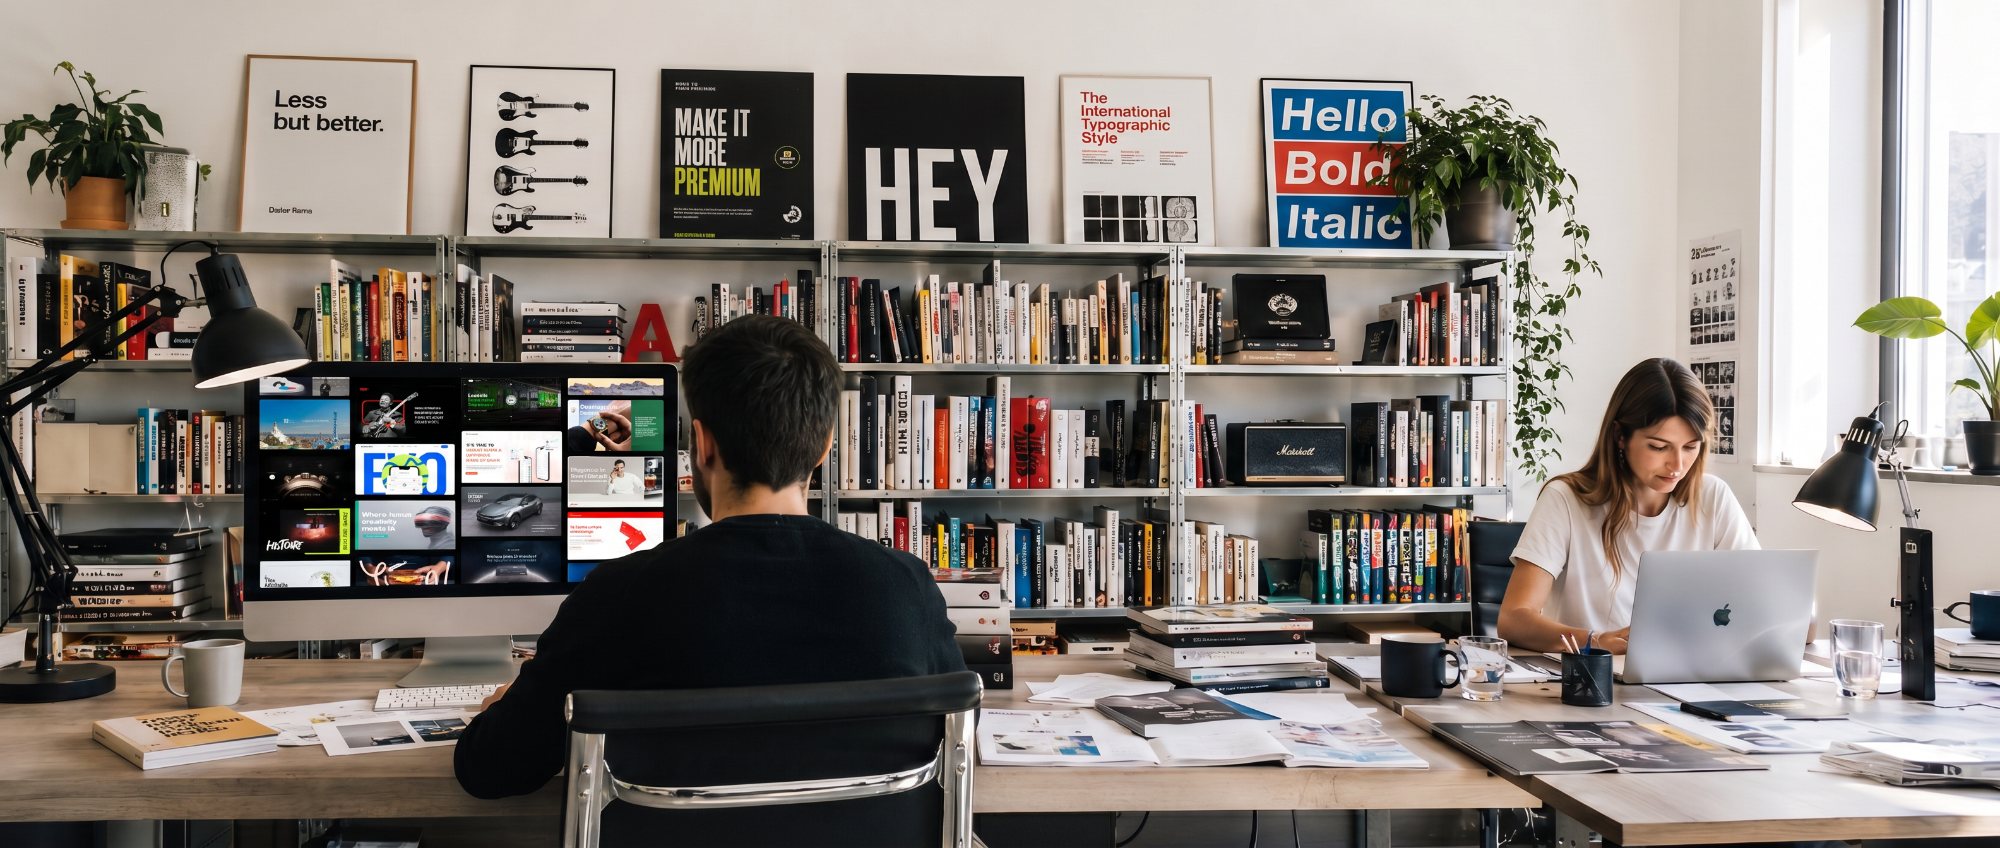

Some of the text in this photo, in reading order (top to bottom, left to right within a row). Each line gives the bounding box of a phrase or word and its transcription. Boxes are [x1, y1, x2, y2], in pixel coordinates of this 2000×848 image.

[274, 89, 328, 109] Less
[1080, 91, 1108, 104] The
[1081, 105, 1171, 119] International
[273, 112, 384, 133] but better.
[675, 108, 751, 137] MAKE IT
[1081, 118, 1171, 134] Typographic
[1281, 97, 1397, 133] Hello
[674, 137, 727, 167] MORE
[1081, 131, 1118, 146] Style
[674, 167, 761, 197] PREMIUM
[1285, 150, 1393, 186] Bold
[865, 147, 1009, 241] HEY
[1287, 204, 1402, 240] Italic
